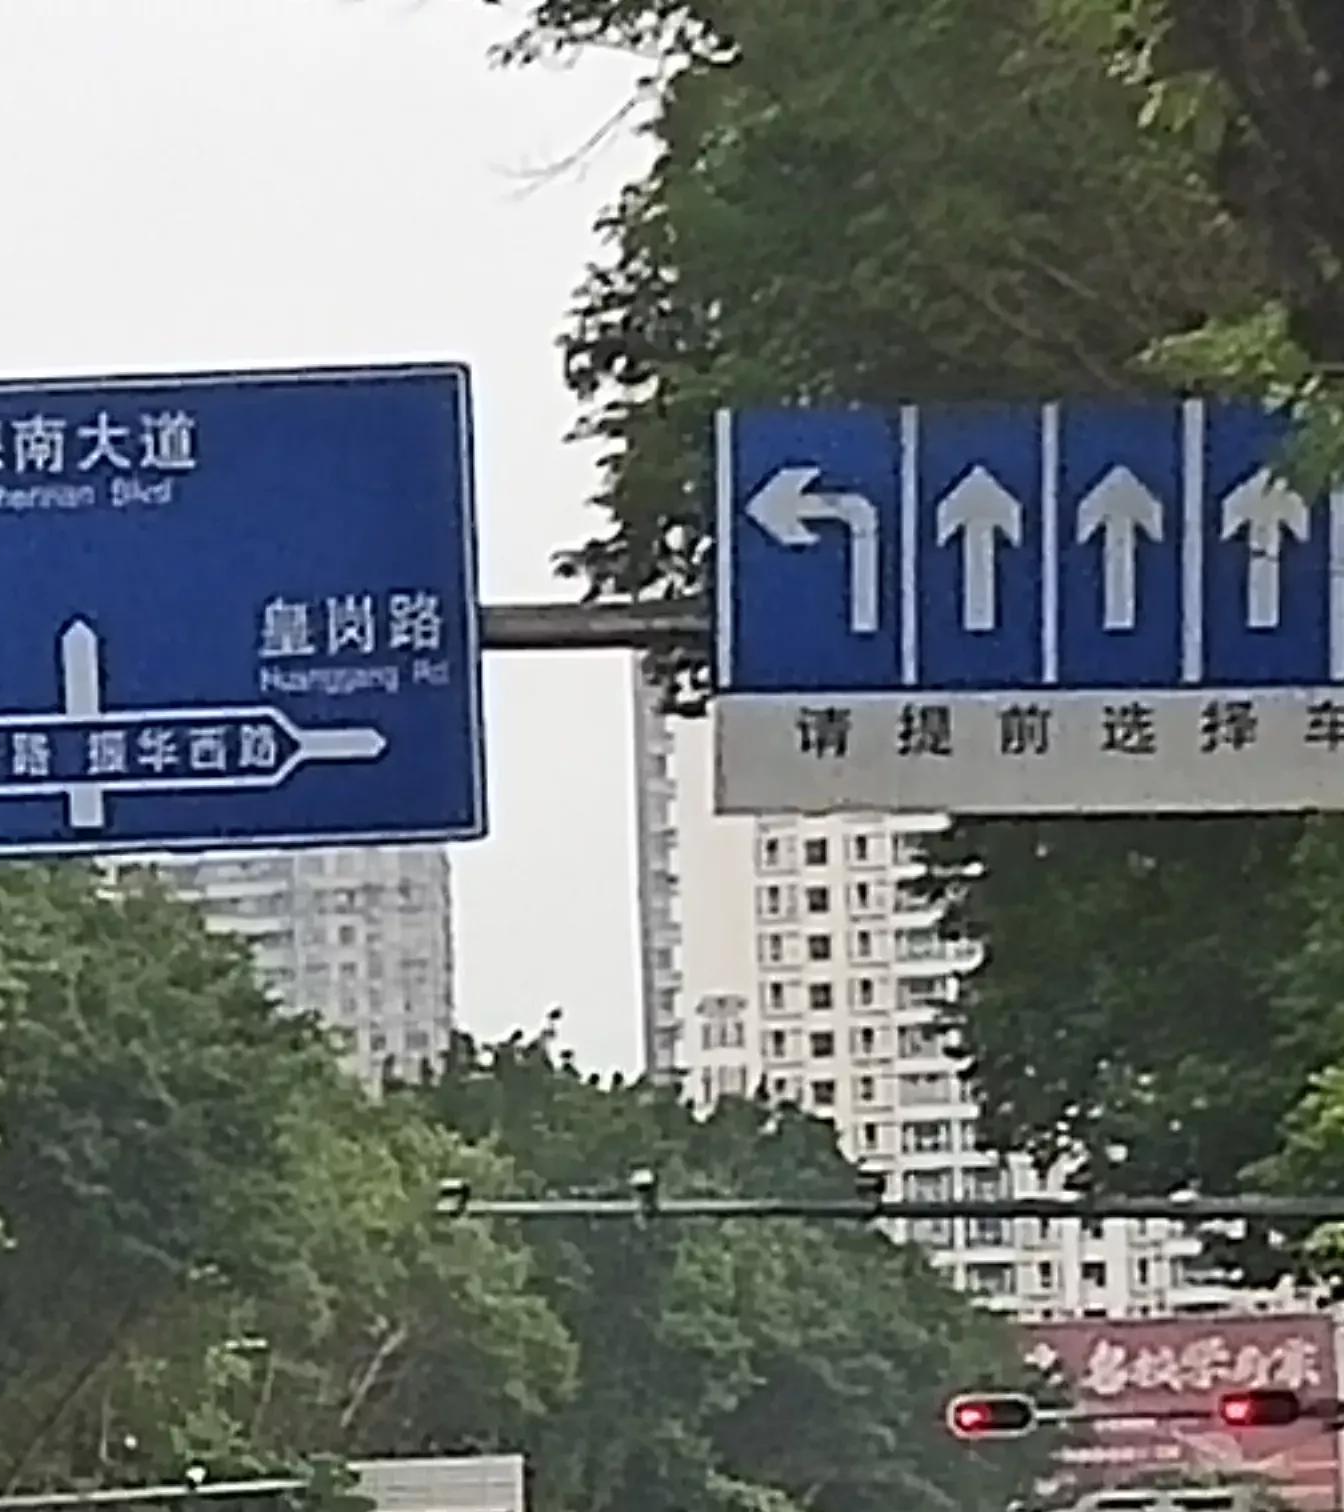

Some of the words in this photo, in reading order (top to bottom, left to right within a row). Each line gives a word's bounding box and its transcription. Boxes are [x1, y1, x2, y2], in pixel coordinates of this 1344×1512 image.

[111, 476, 172, 507] Blvd
[258, 592, 443, 656] 皇岗路
